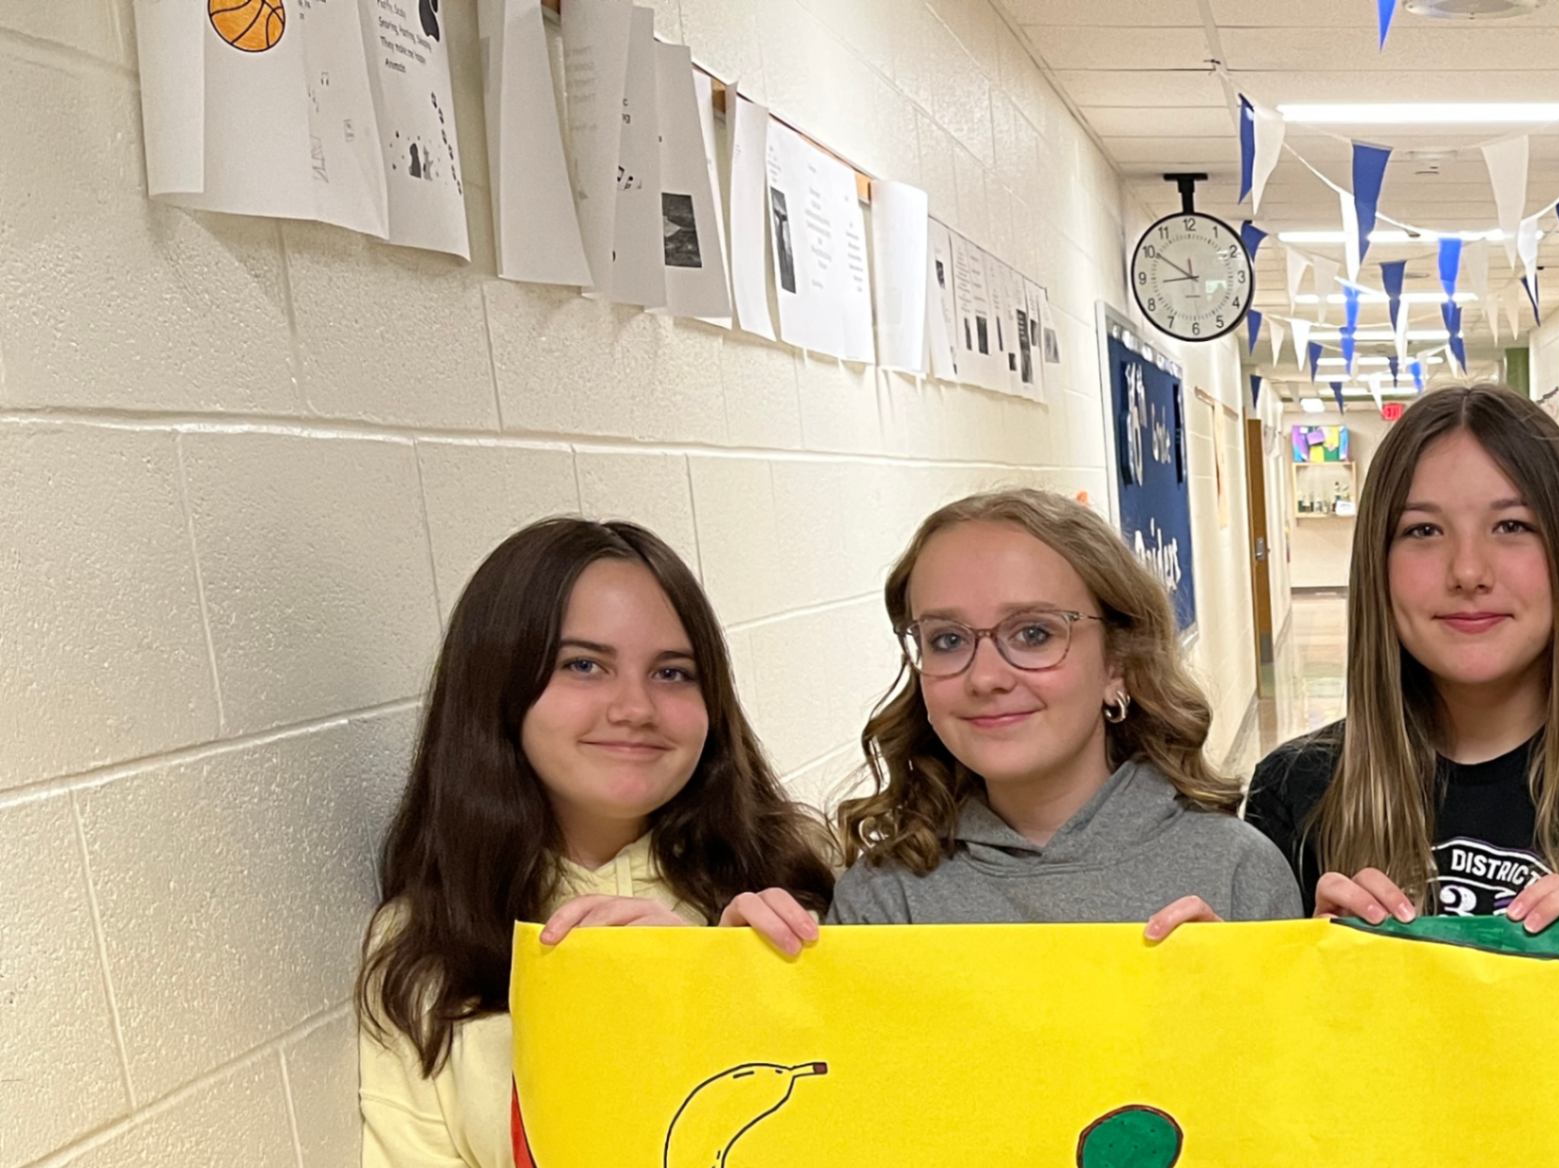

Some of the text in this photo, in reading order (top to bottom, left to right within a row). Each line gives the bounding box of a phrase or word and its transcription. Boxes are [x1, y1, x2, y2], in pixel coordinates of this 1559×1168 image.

[1183, 218, 1196, 231] 12
[1158, 226, 1169, 239] 11
[1213, 226, 1218, 239] 1
[1142, 245, 1156, 258] 10
[1230, 245, 1238, 258] 2
[1138, 272, 1147, 285] 9
[1237, 270, 1246, 284] 3
[1147, 298, 1156, 311] 8
[1232, 296, 1240, 309] 4
[1167, 315, 1175, 329] 7
[1191, 322, 1200, 335] 6
[1216, 315, 1224, 329] 5
[1451, 849, 1542, 888] DISTRICT
